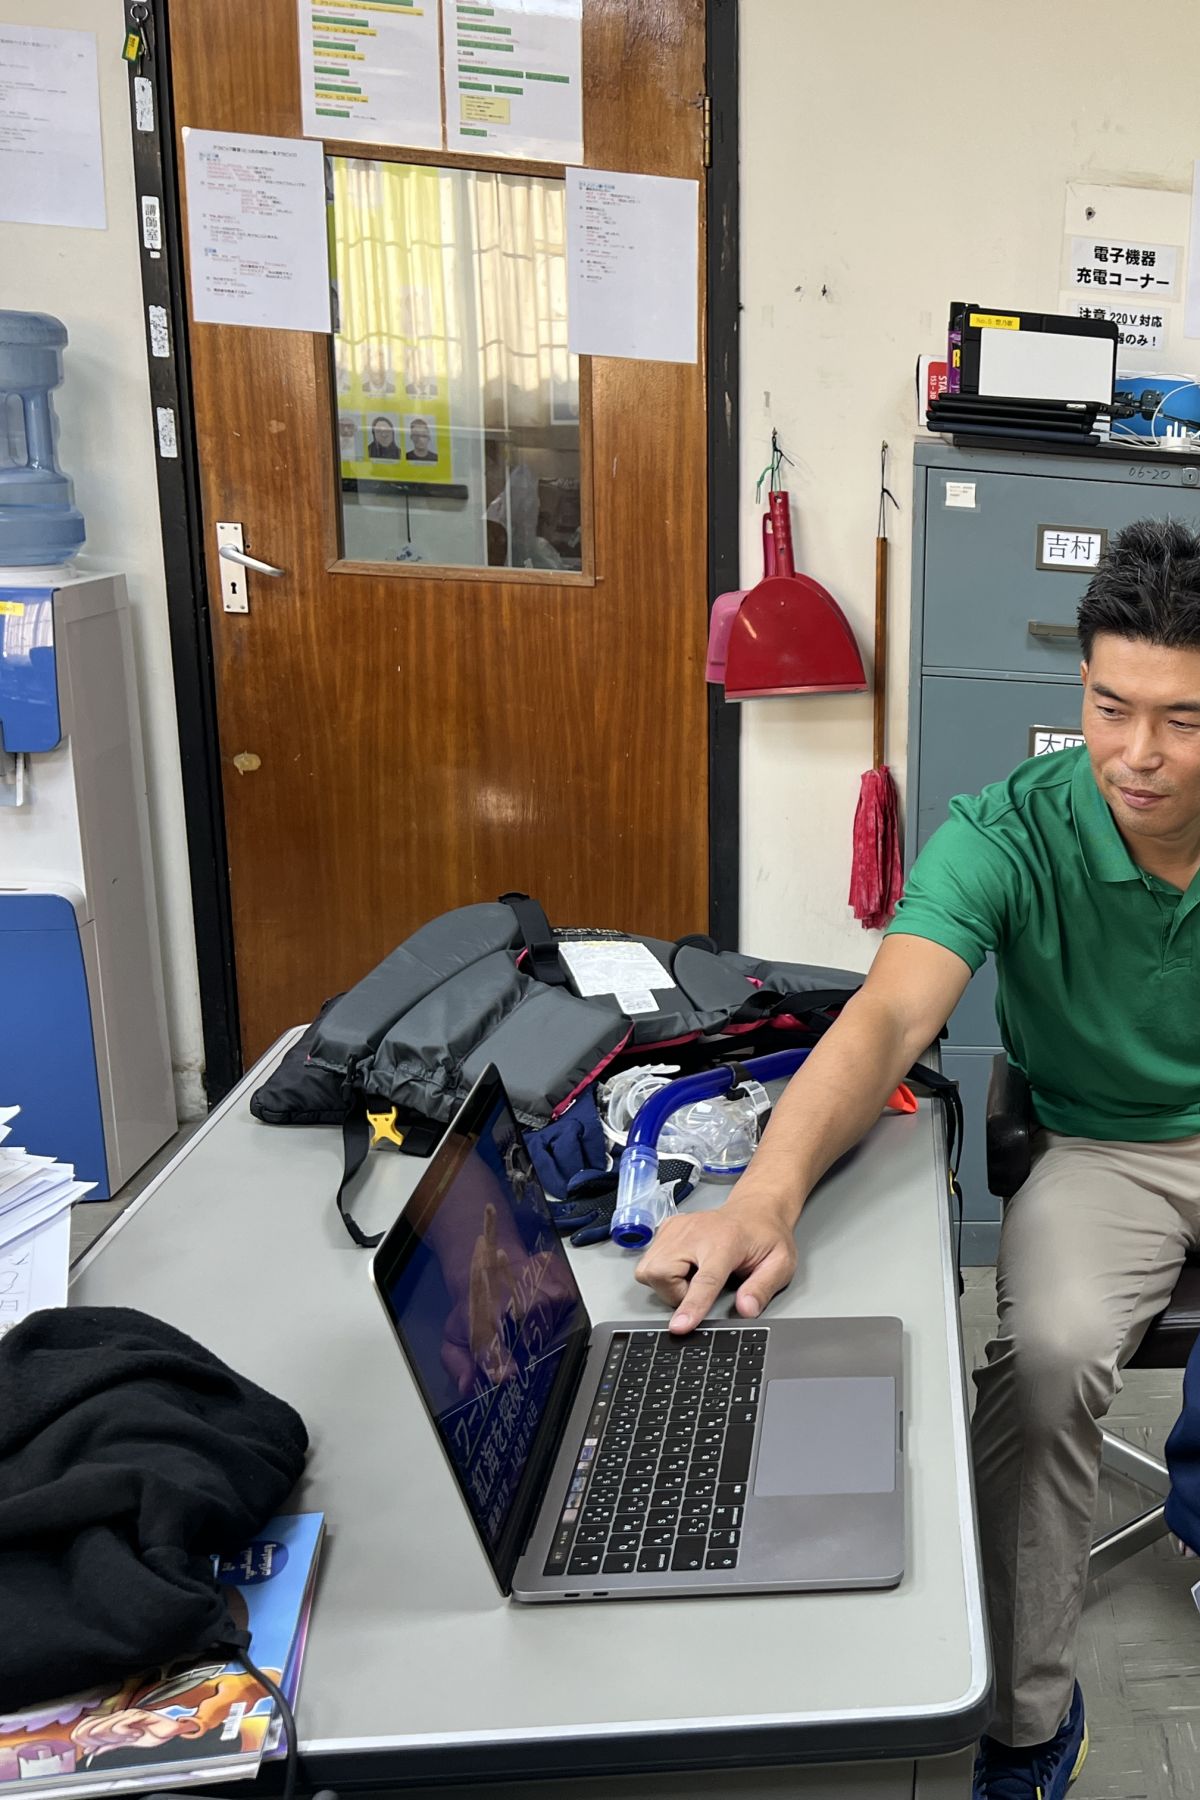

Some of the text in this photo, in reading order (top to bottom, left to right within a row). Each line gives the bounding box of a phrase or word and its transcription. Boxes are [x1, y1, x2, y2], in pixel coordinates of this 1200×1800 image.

[145, 203, 158, 241] 講師室
[1093, 245, 1157, 267] 電子機器
[1076, 267, 1170, 290] 充電コーナー
[1046, 533, 1096, 561] 吉村
